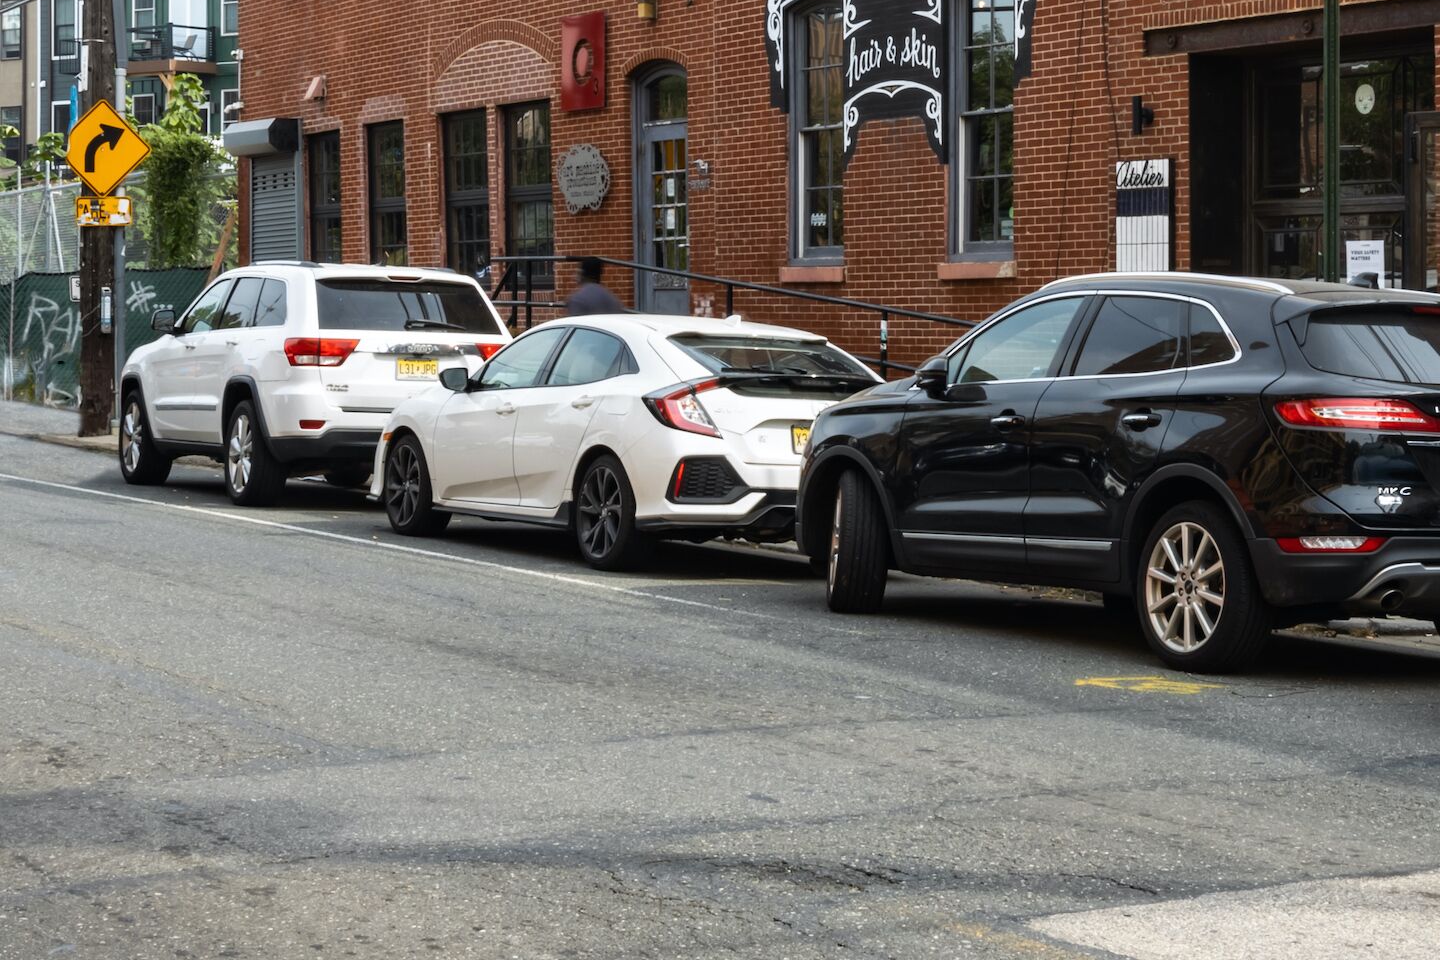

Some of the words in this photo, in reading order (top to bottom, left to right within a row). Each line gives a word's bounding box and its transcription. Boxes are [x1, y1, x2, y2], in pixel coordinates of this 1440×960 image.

[846, 36, 882, 88] hair
[885, 35, 896, 62] &
[899, 27, 941, 79] skin
[1115, 160, 1164, 188] Atelier
[1378, 486, 1412, 496] MKC
